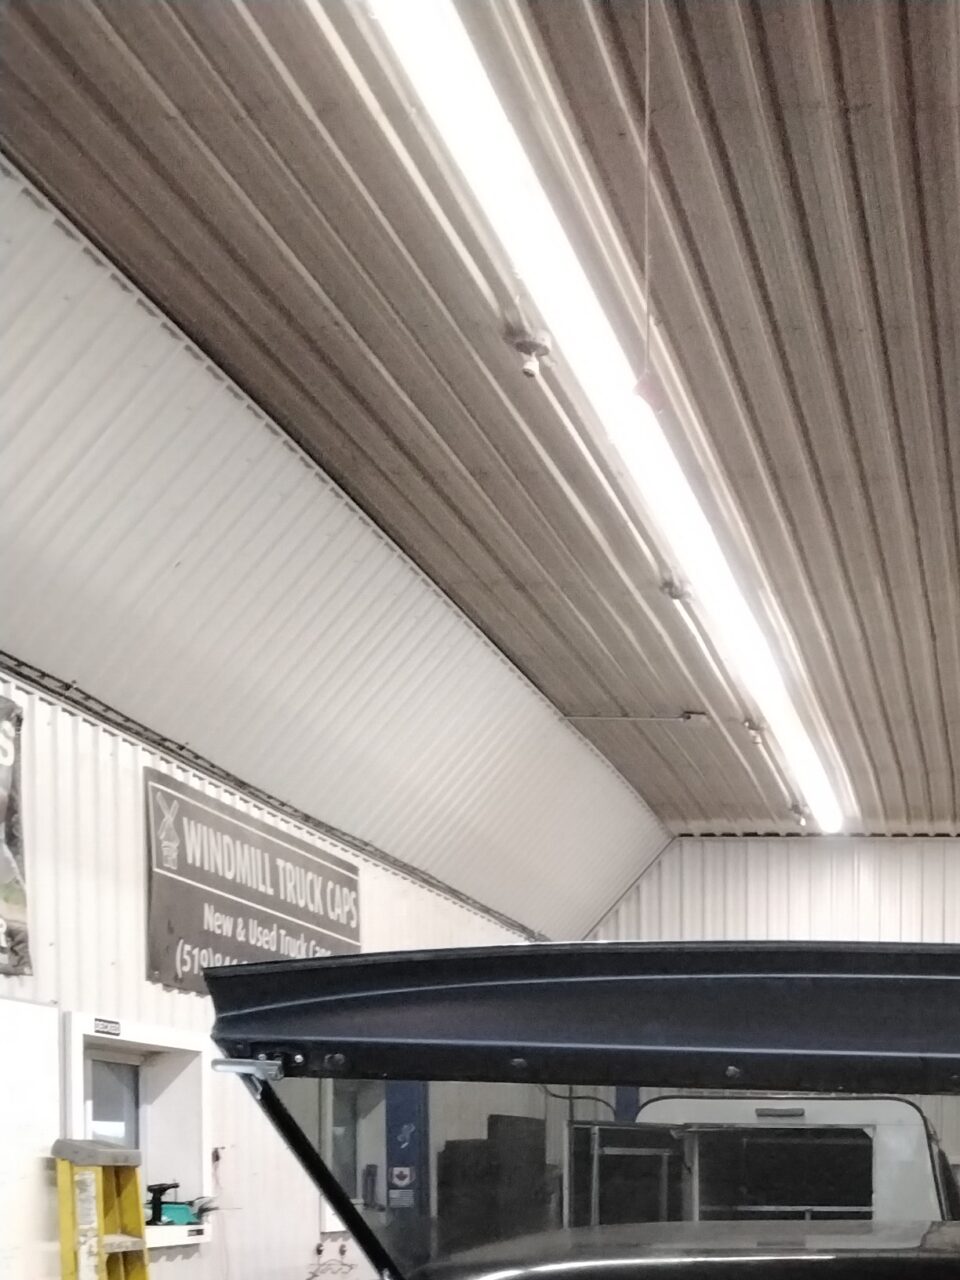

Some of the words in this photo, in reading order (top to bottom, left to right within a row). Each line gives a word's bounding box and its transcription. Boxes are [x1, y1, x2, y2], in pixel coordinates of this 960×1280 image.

[182, 816, 274, 895] WINDMILL
[276, 858, 324, 915] TRUCK
[327, 880, 357, 928] CAPS
[203, 903, 233, 937] New
[236, 917, 246, 942] &
[249, 918, 277, 951] Used
[279, 929, 308, 959] Truck
